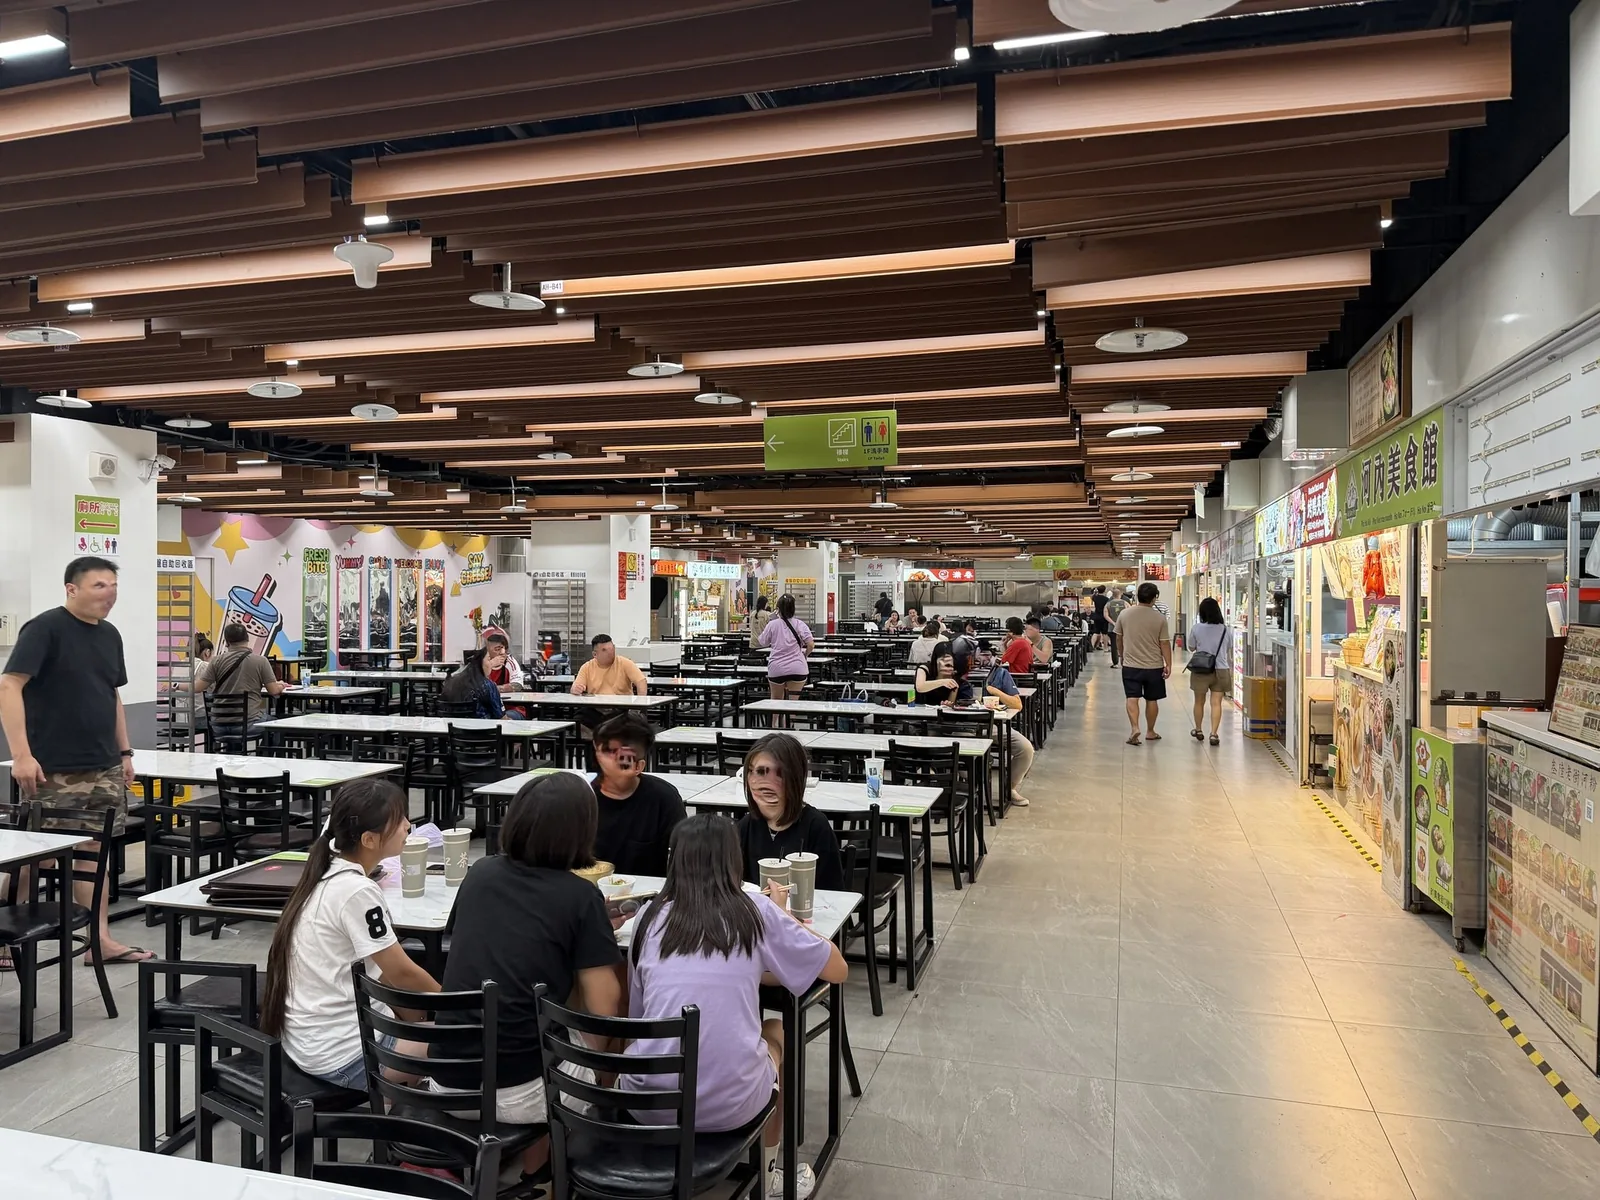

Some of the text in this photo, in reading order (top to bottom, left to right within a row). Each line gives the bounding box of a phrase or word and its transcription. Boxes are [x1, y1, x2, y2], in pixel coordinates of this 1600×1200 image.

[1361, 421, 1440, 508] 河內美食館
[303, 547, 330, 561] FRESH
[365, 905, 388, 940] 8
